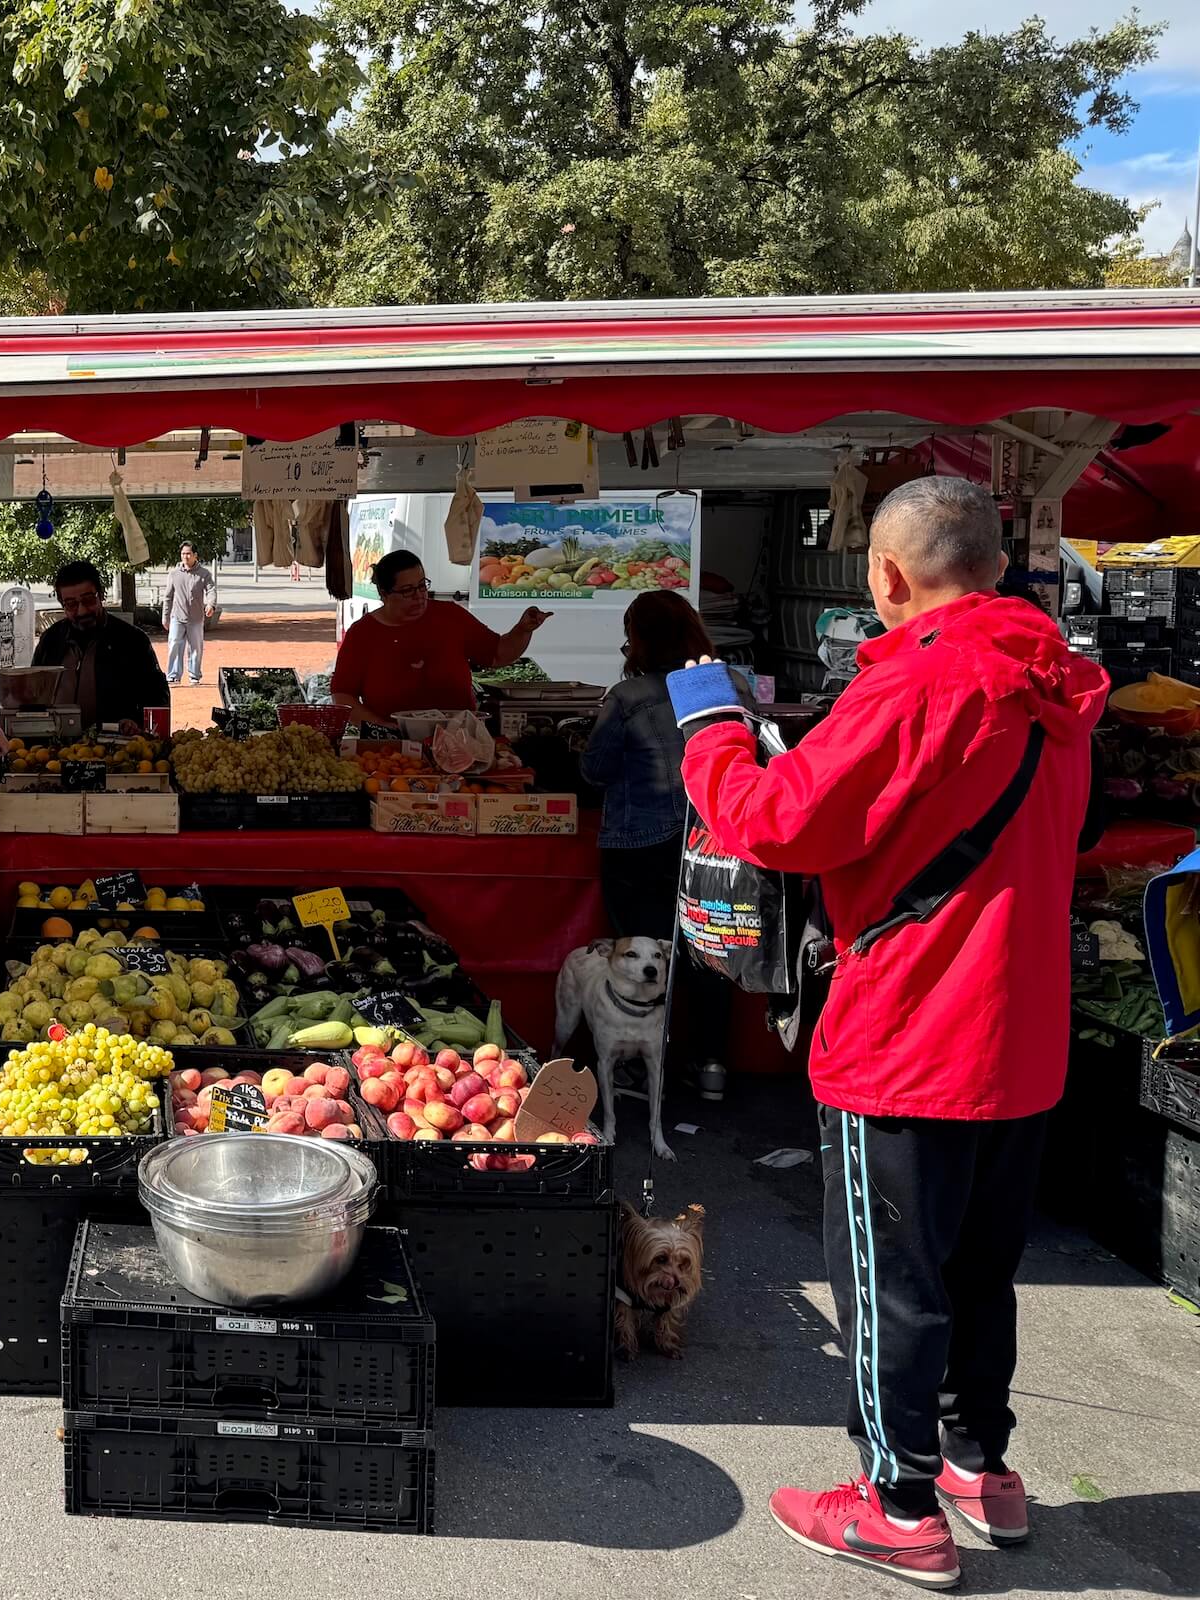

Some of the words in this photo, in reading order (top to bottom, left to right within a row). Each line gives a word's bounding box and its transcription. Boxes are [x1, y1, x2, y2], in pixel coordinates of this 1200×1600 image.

[286, 462, 302, 480] 10
[568, 508, 665, 523] PRIMEUR
[482, 589, 528, 598] Livraison
[531, 589, 537, 598] à
[540, 589, 582, 598] domicile
[390, 816, 417, 833] Villa
[421, 818, 460, 833] Maria
[490, 818, 518, 834] Villa
[521, 820, 561, 834] Maria
[700, 899, 732, 912] meubles
[213, 1087, 231, 1104] Prix
[228, 1321, 250, 1330] IFCO
[231, 1425, 253, 1435] IFCO
[1000, 1480, 1017, 1490] NIKE
